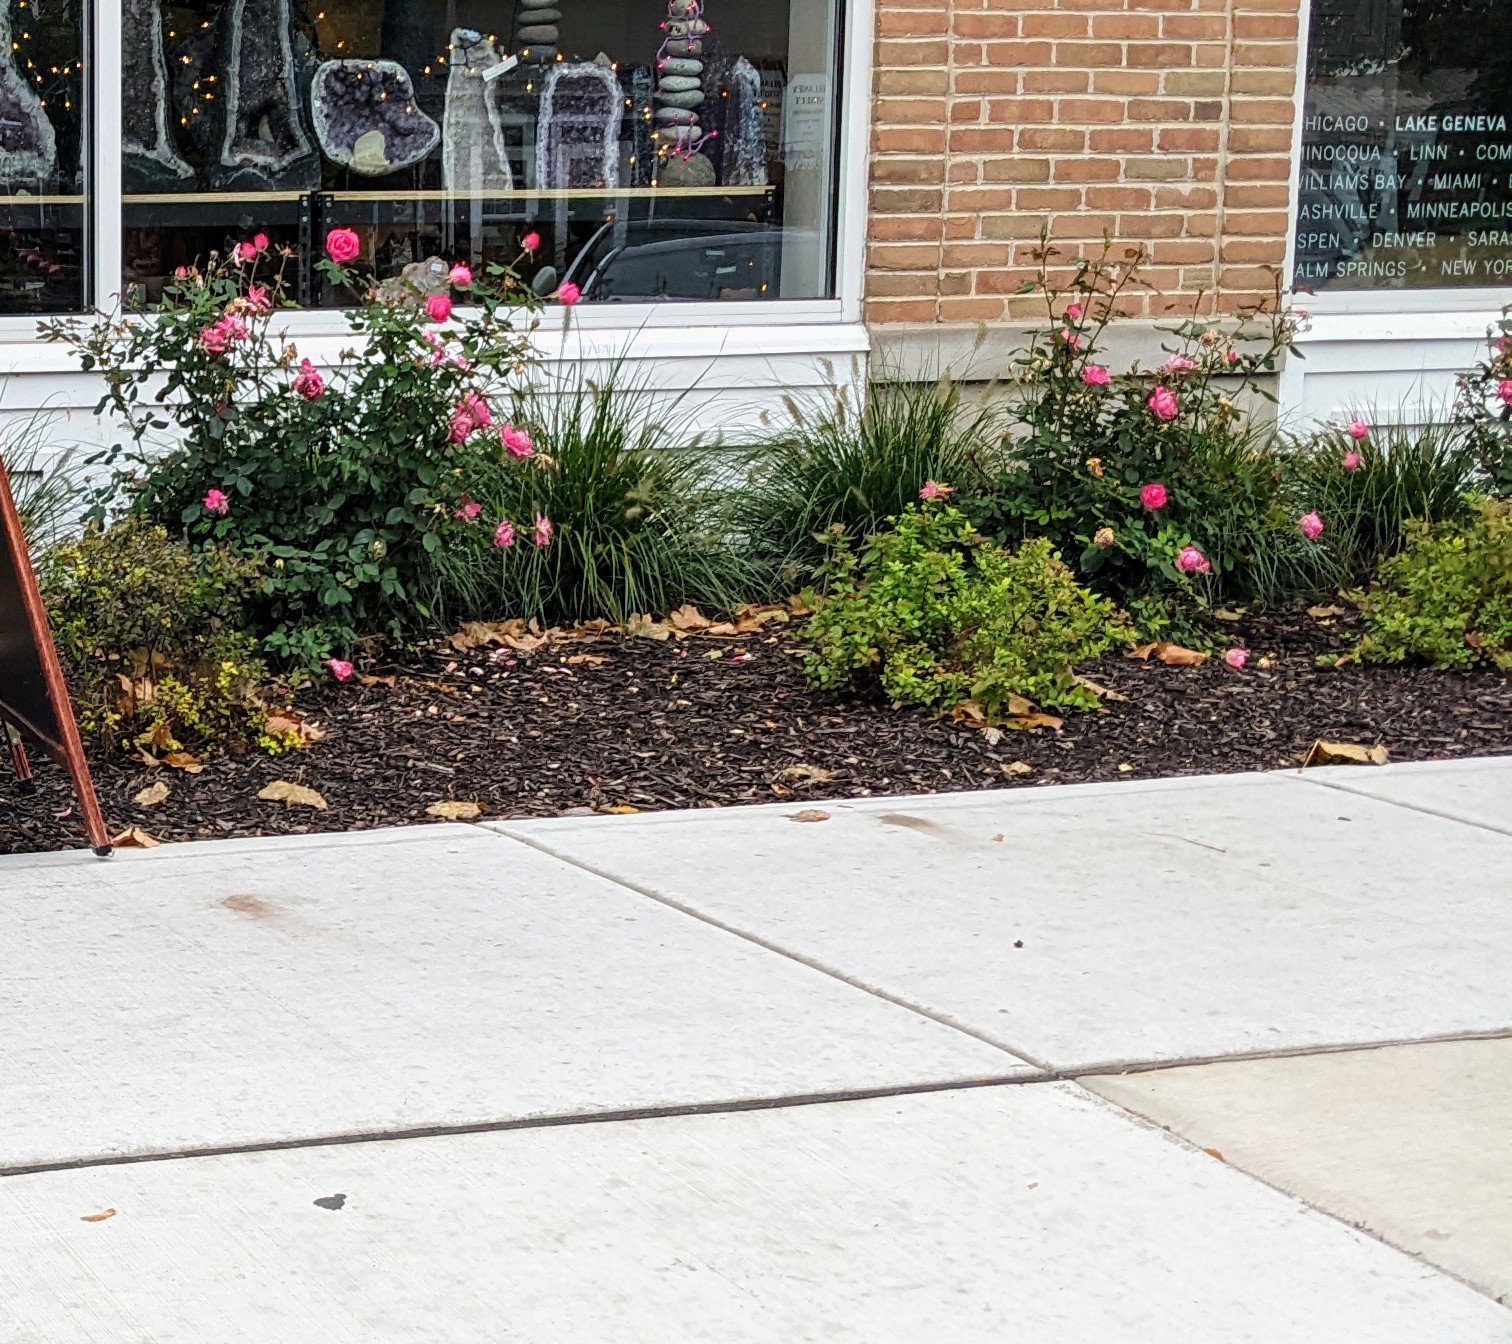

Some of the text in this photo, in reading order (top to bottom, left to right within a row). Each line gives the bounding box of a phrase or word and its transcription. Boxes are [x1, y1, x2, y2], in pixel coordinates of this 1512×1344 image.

[1305, 115, 1507, 132] HICAGO LAKE GENEVA
[1410, 144, 1448, 161] LINN
[1374, 173, 1407, 190] BAY
[1433, 173, 1482, 190] MIAMI
[1300, 201, 1512, 220] ASHVILLE MINNEAPOLIS
[1297, 232, 1340, 249] SPEN
[1372, 231, 1437, 248] DENVER
[1295, 261, 1329, 278] ALM
[1336, 260, 1407, 277] SPRINGS
[1441, 259, 1477, 276] NEW
